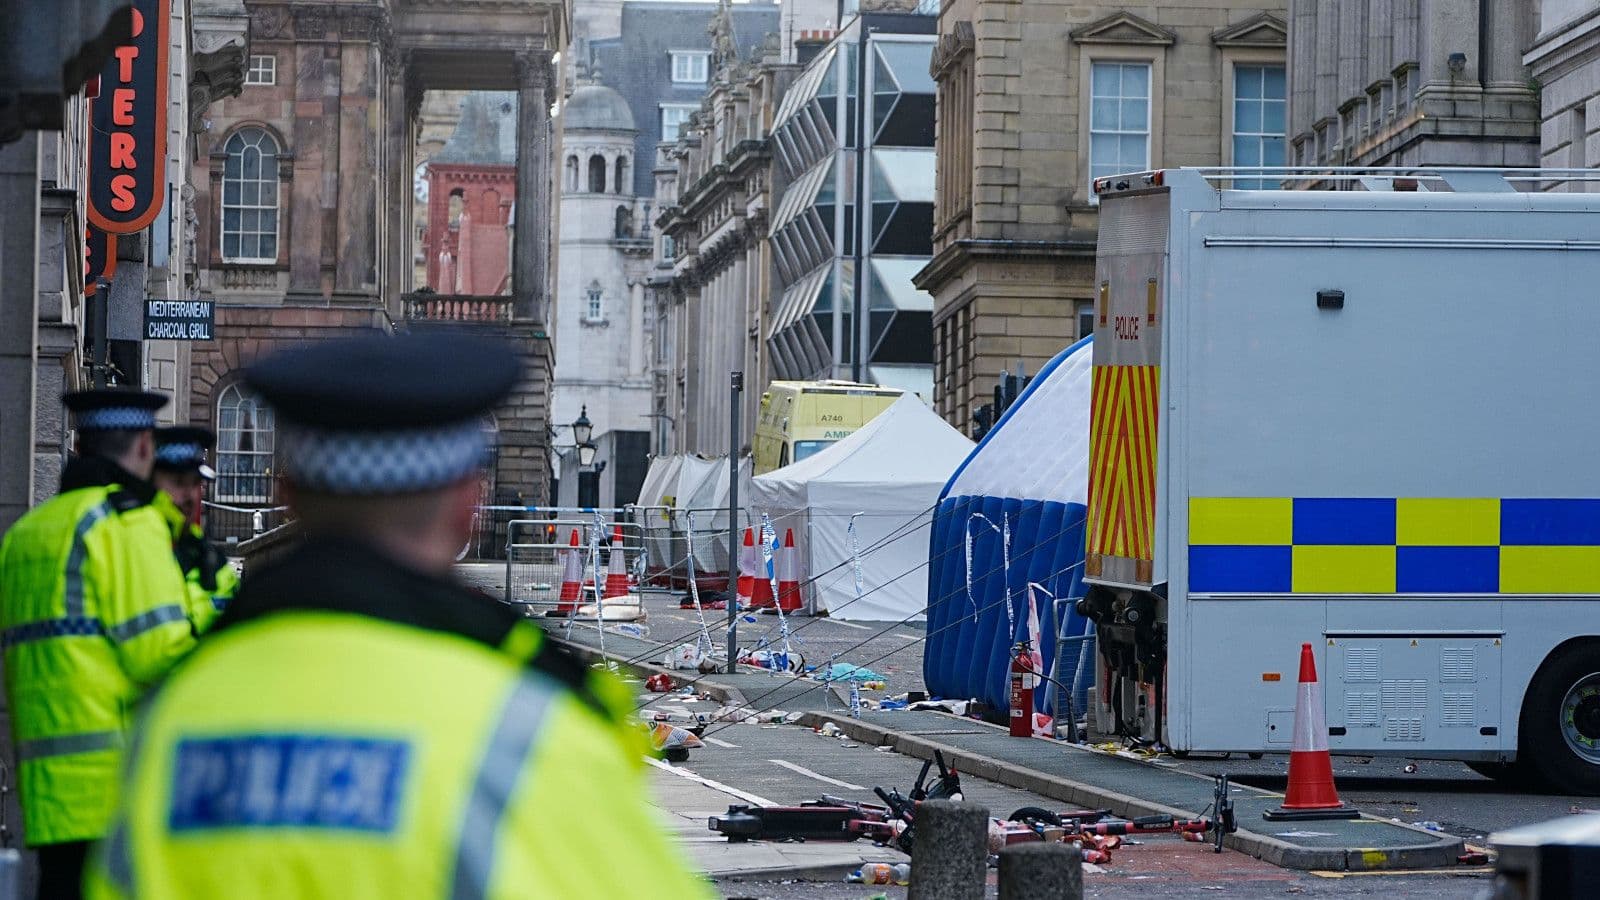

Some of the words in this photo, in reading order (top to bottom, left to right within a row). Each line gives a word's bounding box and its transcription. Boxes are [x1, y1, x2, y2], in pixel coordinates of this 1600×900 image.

[148, 301, 210, 318] MEDITERRANEAN
[148, 322, 188, 339] CHARCOAL
[189, 323, 210, 339] GRILL
[1115, 315, 1139, 340] POLICE
[820, 414, 843, 422] A740
